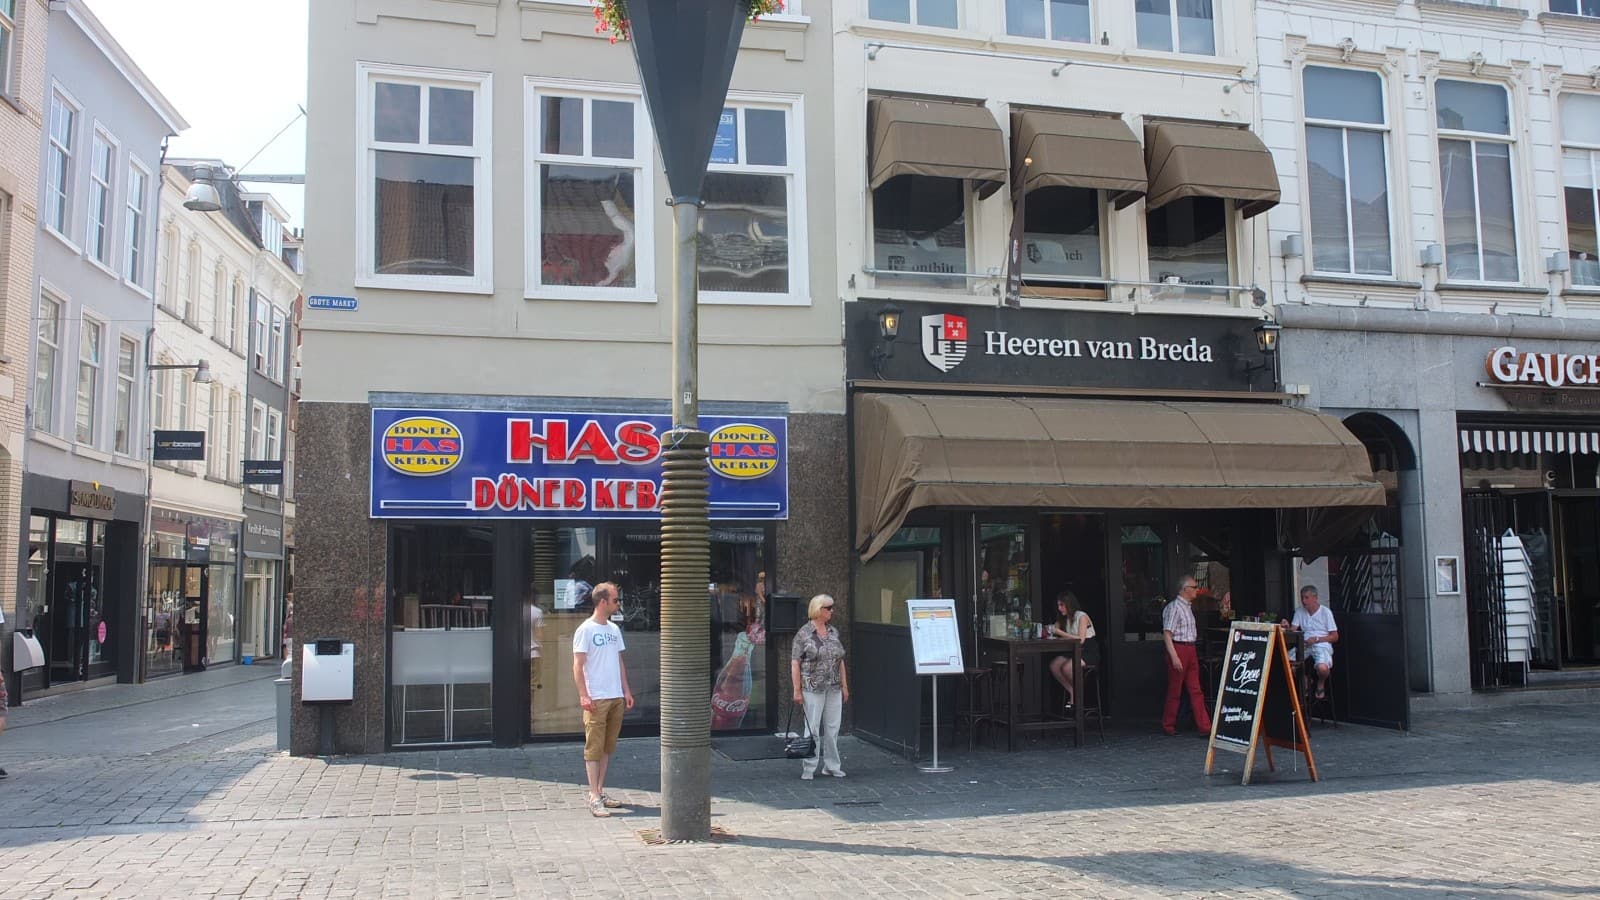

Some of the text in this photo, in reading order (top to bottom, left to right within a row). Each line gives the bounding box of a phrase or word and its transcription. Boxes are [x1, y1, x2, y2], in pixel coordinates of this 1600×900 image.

[310, 298, 356, 308] GROTE MARKT
[984, 331, 1214, 364] Heeren van Breda
[394, 426, 452, 436] DONER
[718, 432, 770, 442] DONER
[386, 438, 459, 452] HAS
[507, 418, 663, 465] HAS
[711, 443, 776, 457] HAS
[394, 456, 450, 466] KEBAB
[719, 461, 769, 470] KEBAB
[473, 474, 586, 511] DÖNER
[1233, 661, 1261, 685] Open
